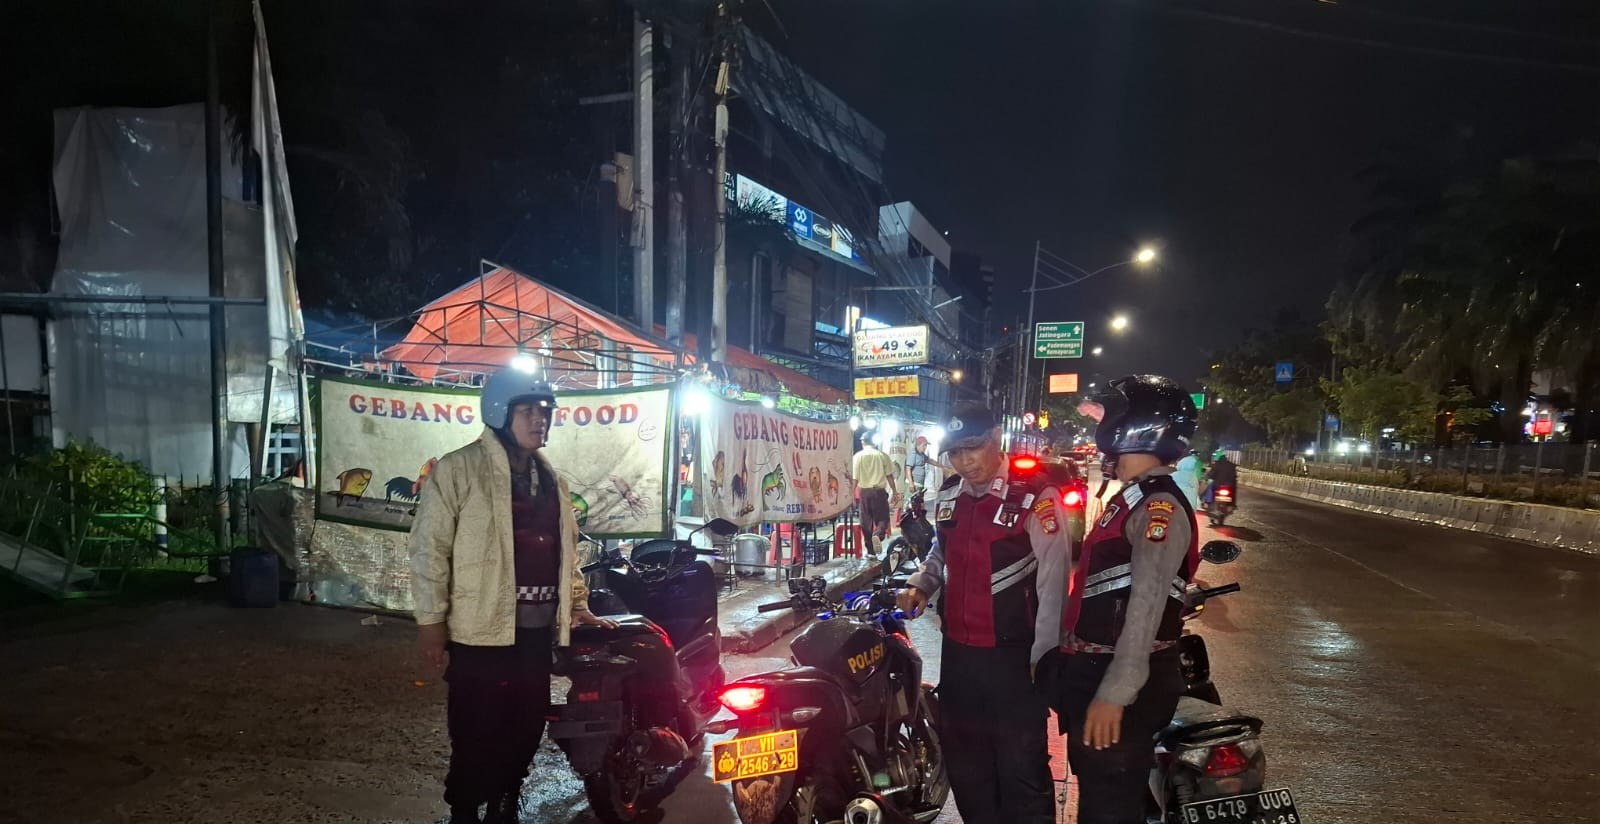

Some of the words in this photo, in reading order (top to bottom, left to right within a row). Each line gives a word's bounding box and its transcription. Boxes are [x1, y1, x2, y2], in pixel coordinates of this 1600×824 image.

[882, 341, 899, 352] 49
[865, 380, 907, 396] LELE
[348, 394, 475, 425] GEBANG
[553, 403, 639, 427] FOOD
[733, 412, 789, 446] GEBANG
[792, 425, 839, 451] SEAFOOD
[847, 642, 884, 674] POLISI
[760, 735, 775, 753] VII
[1187, 807, 1200, 823] B
[1205, 799, 1247, 820] 6478
